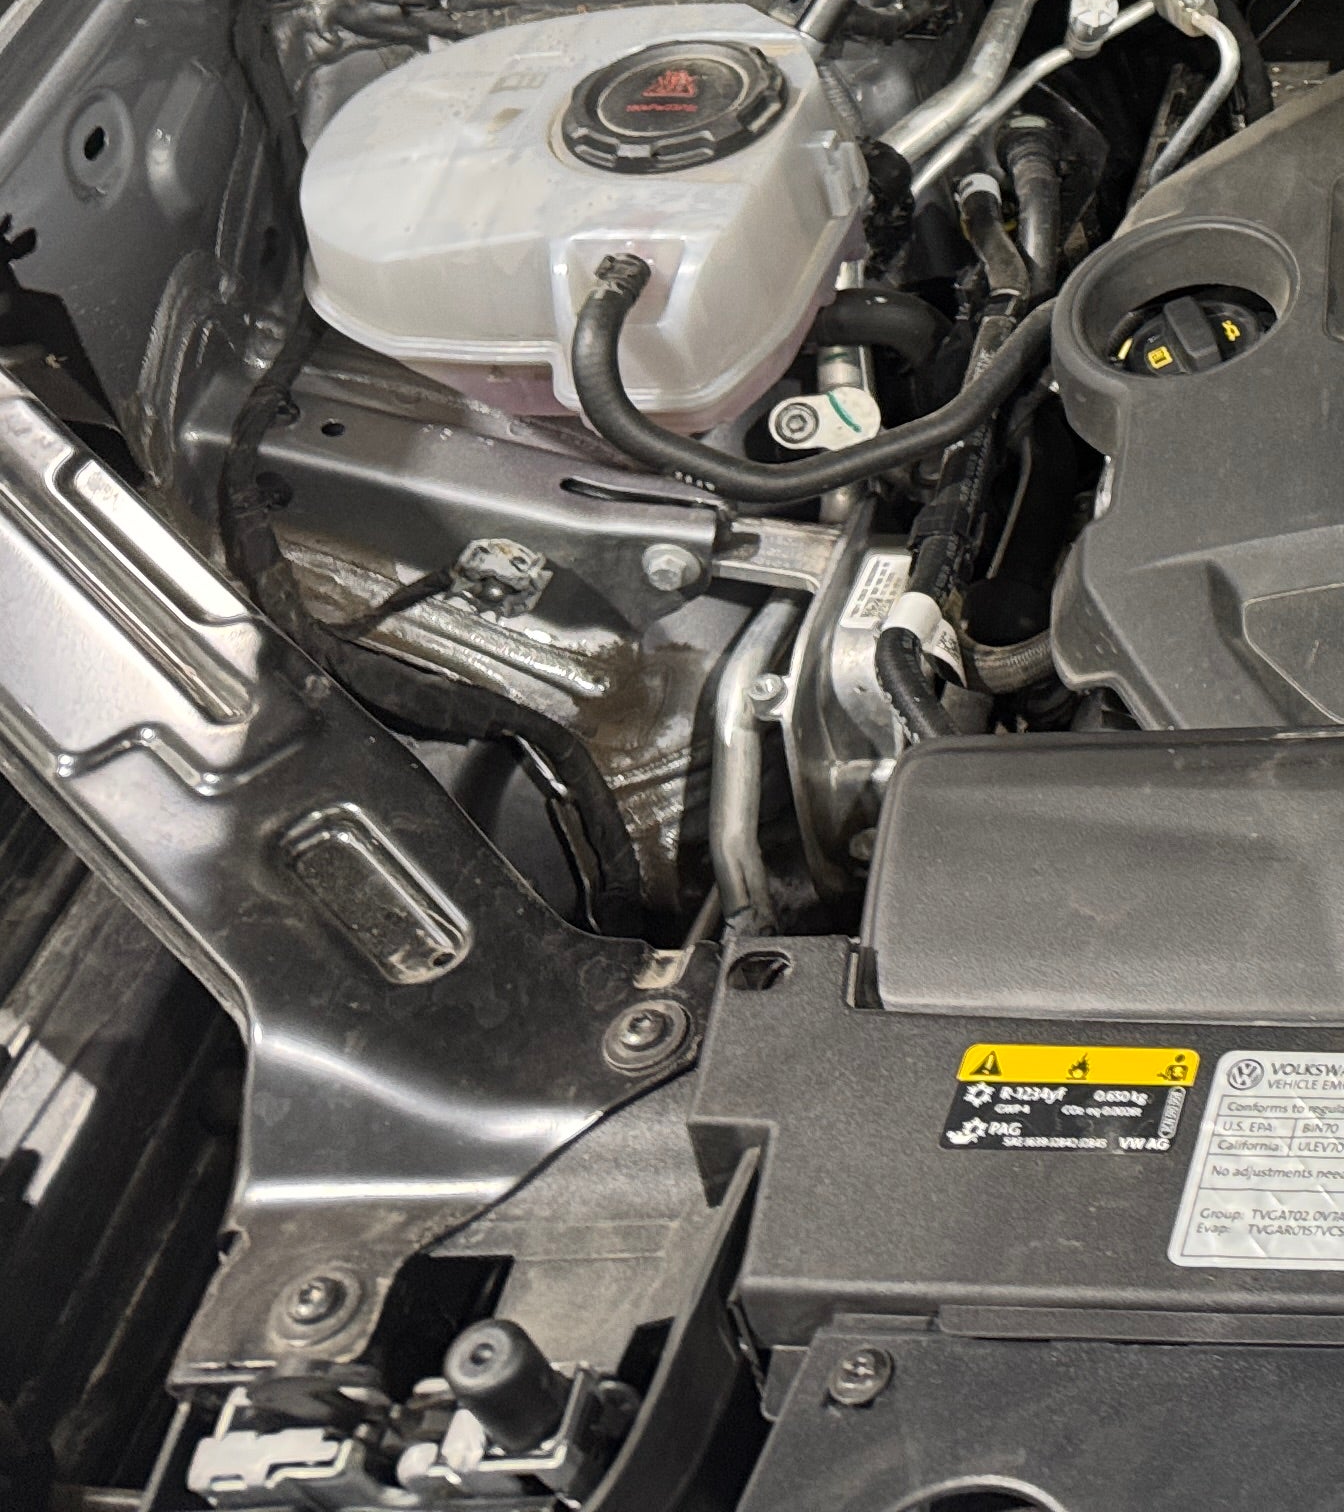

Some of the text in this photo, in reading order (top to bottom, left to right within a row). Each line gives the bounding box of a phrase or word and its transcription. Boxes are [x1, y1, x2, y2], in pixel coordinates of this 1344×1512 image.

[1267, 1079, 1318, 1090] VEHICLE
[1227, 1101, 1288, 1113] Conforms
[1291, 1103, 1305, 1113] to
[987, 1121, 1022, 1136] PAG
[1302, 1123, 1339, 1134] BIN70
[1118, 1136, 1146, 1150] VW
[1145, 1137, 1172, 1151] AG
[1298, 1142, 1344, 1153] ULEV70
[1211, 1165, 1230, 1176] No
[1232, 1166, 1312, 1181] adjustments
